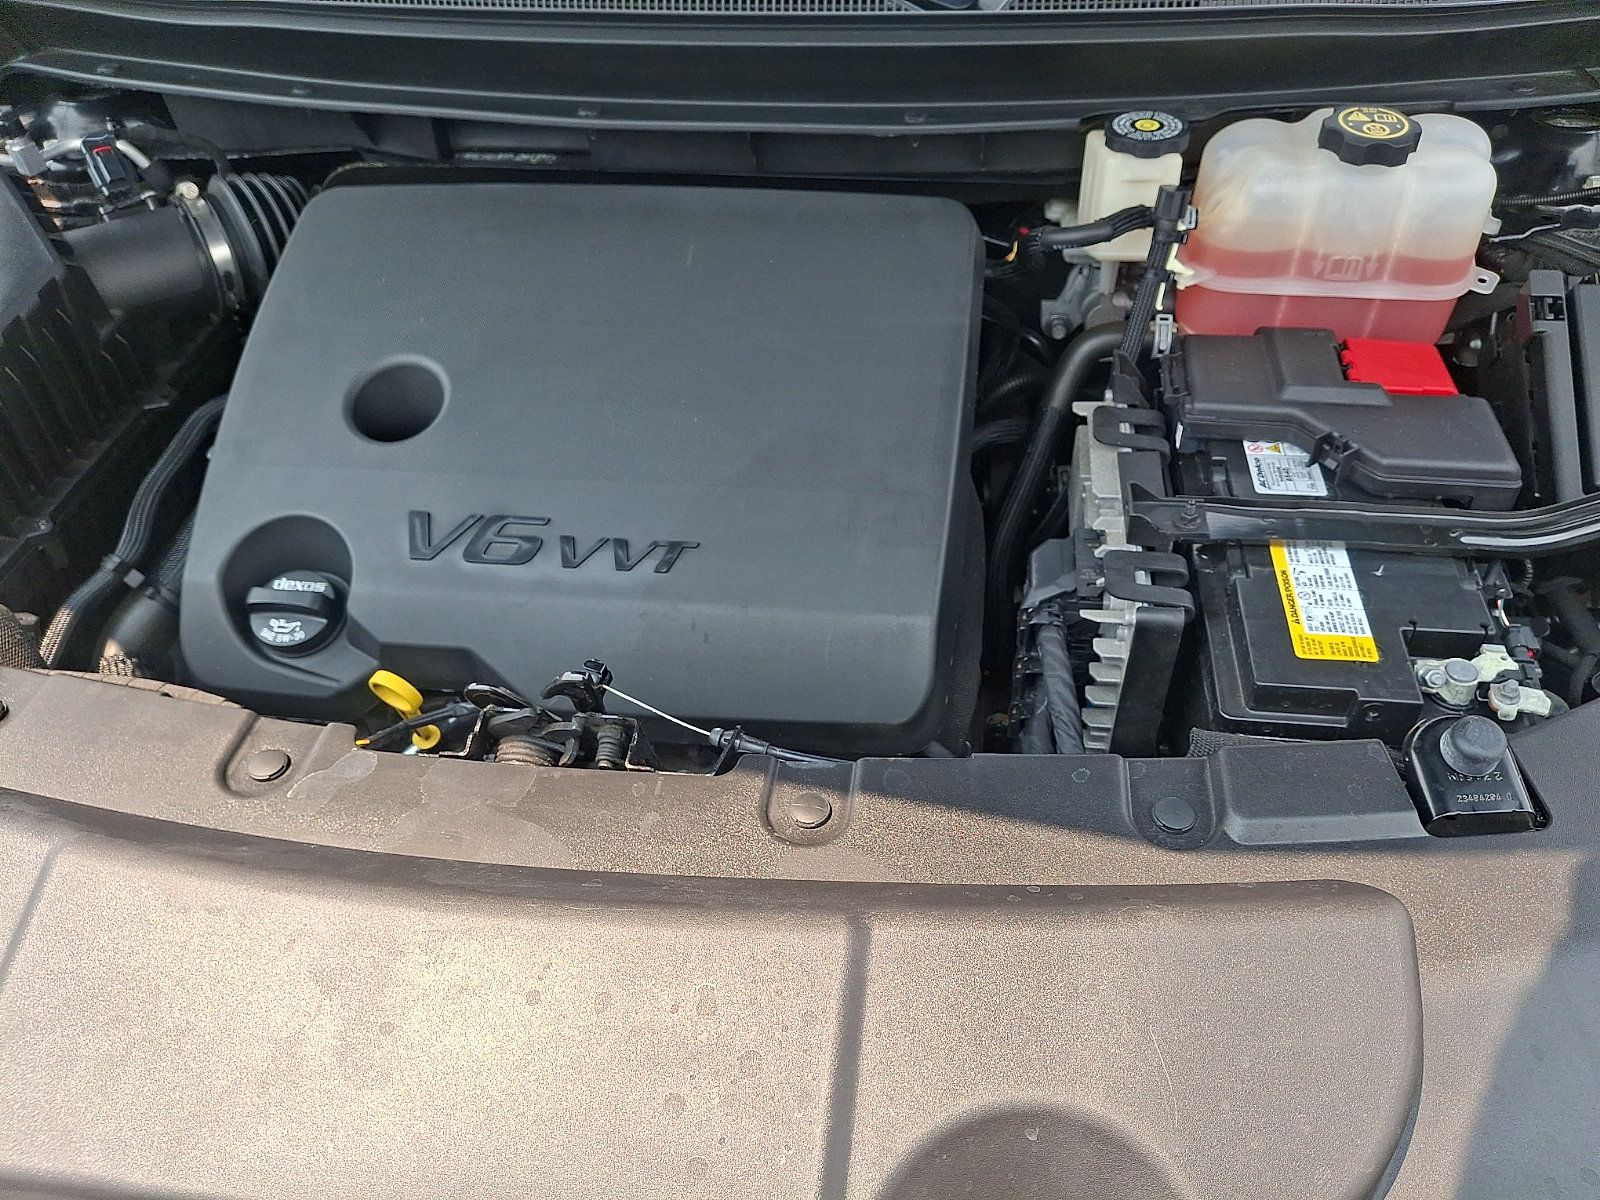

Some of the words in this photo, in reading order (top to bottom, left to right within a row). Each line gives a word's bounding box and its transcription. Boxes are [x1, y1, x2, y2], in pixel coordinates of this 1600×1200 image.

[408, 510, 550, 565] V6
[559, 535, 700, 573] VVT
[272, 577, 328, 593] dexos
[1280, 569, 1292, 592] POISON
[1287, 593, 1298, 618] DANGER
